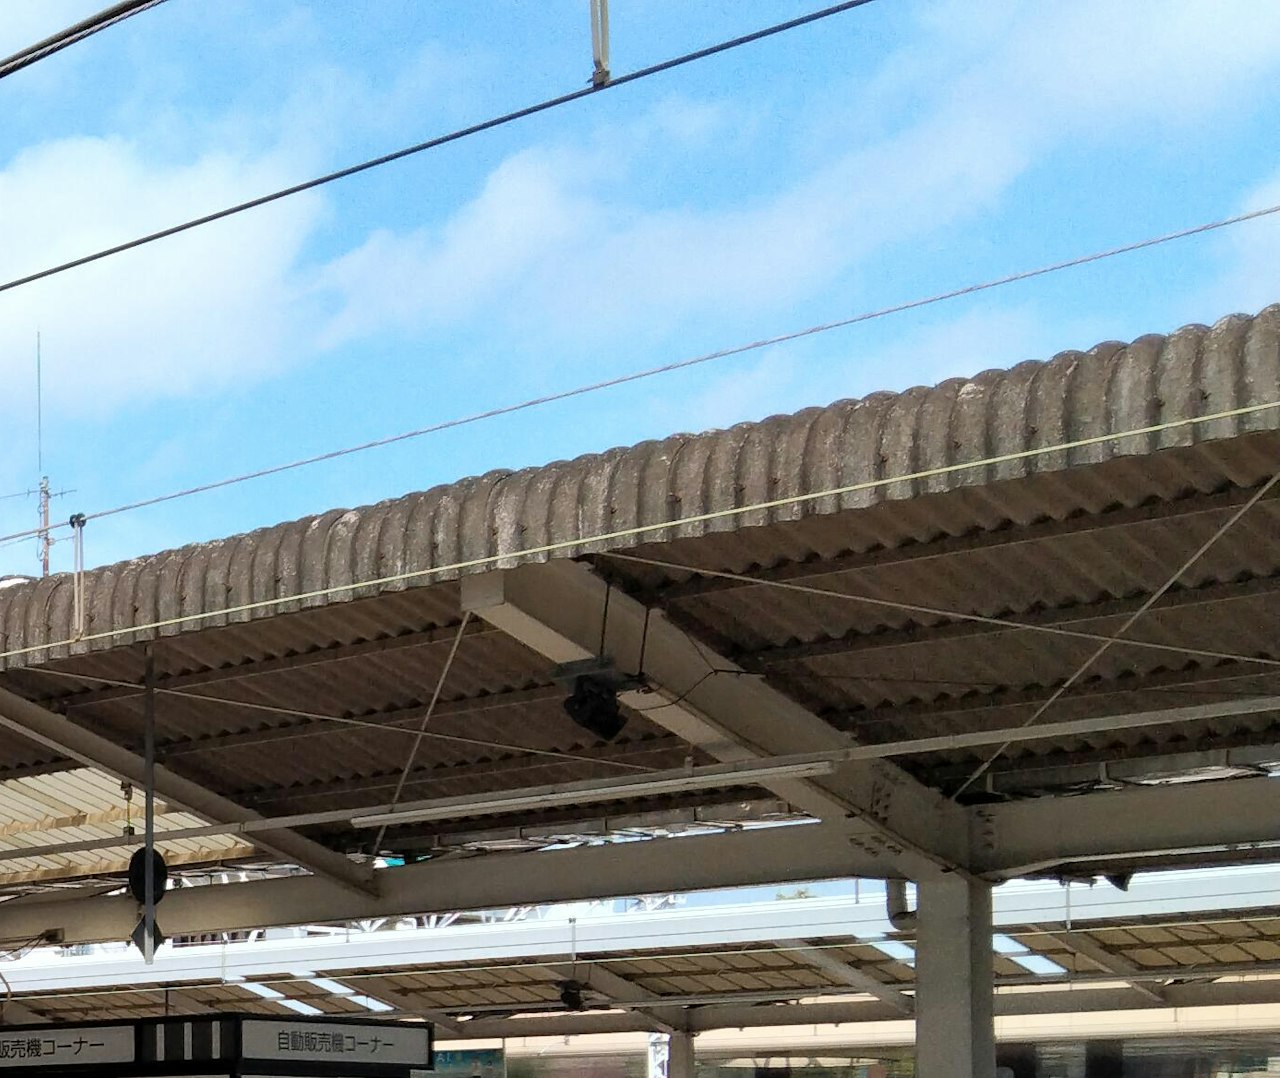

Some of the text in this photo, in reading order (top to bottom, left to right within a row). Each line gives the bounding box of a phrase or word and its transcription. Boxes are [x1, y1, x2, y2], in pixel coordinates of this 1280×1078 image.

[278, 1030, 395, 1053] 自動販売機コーナー
